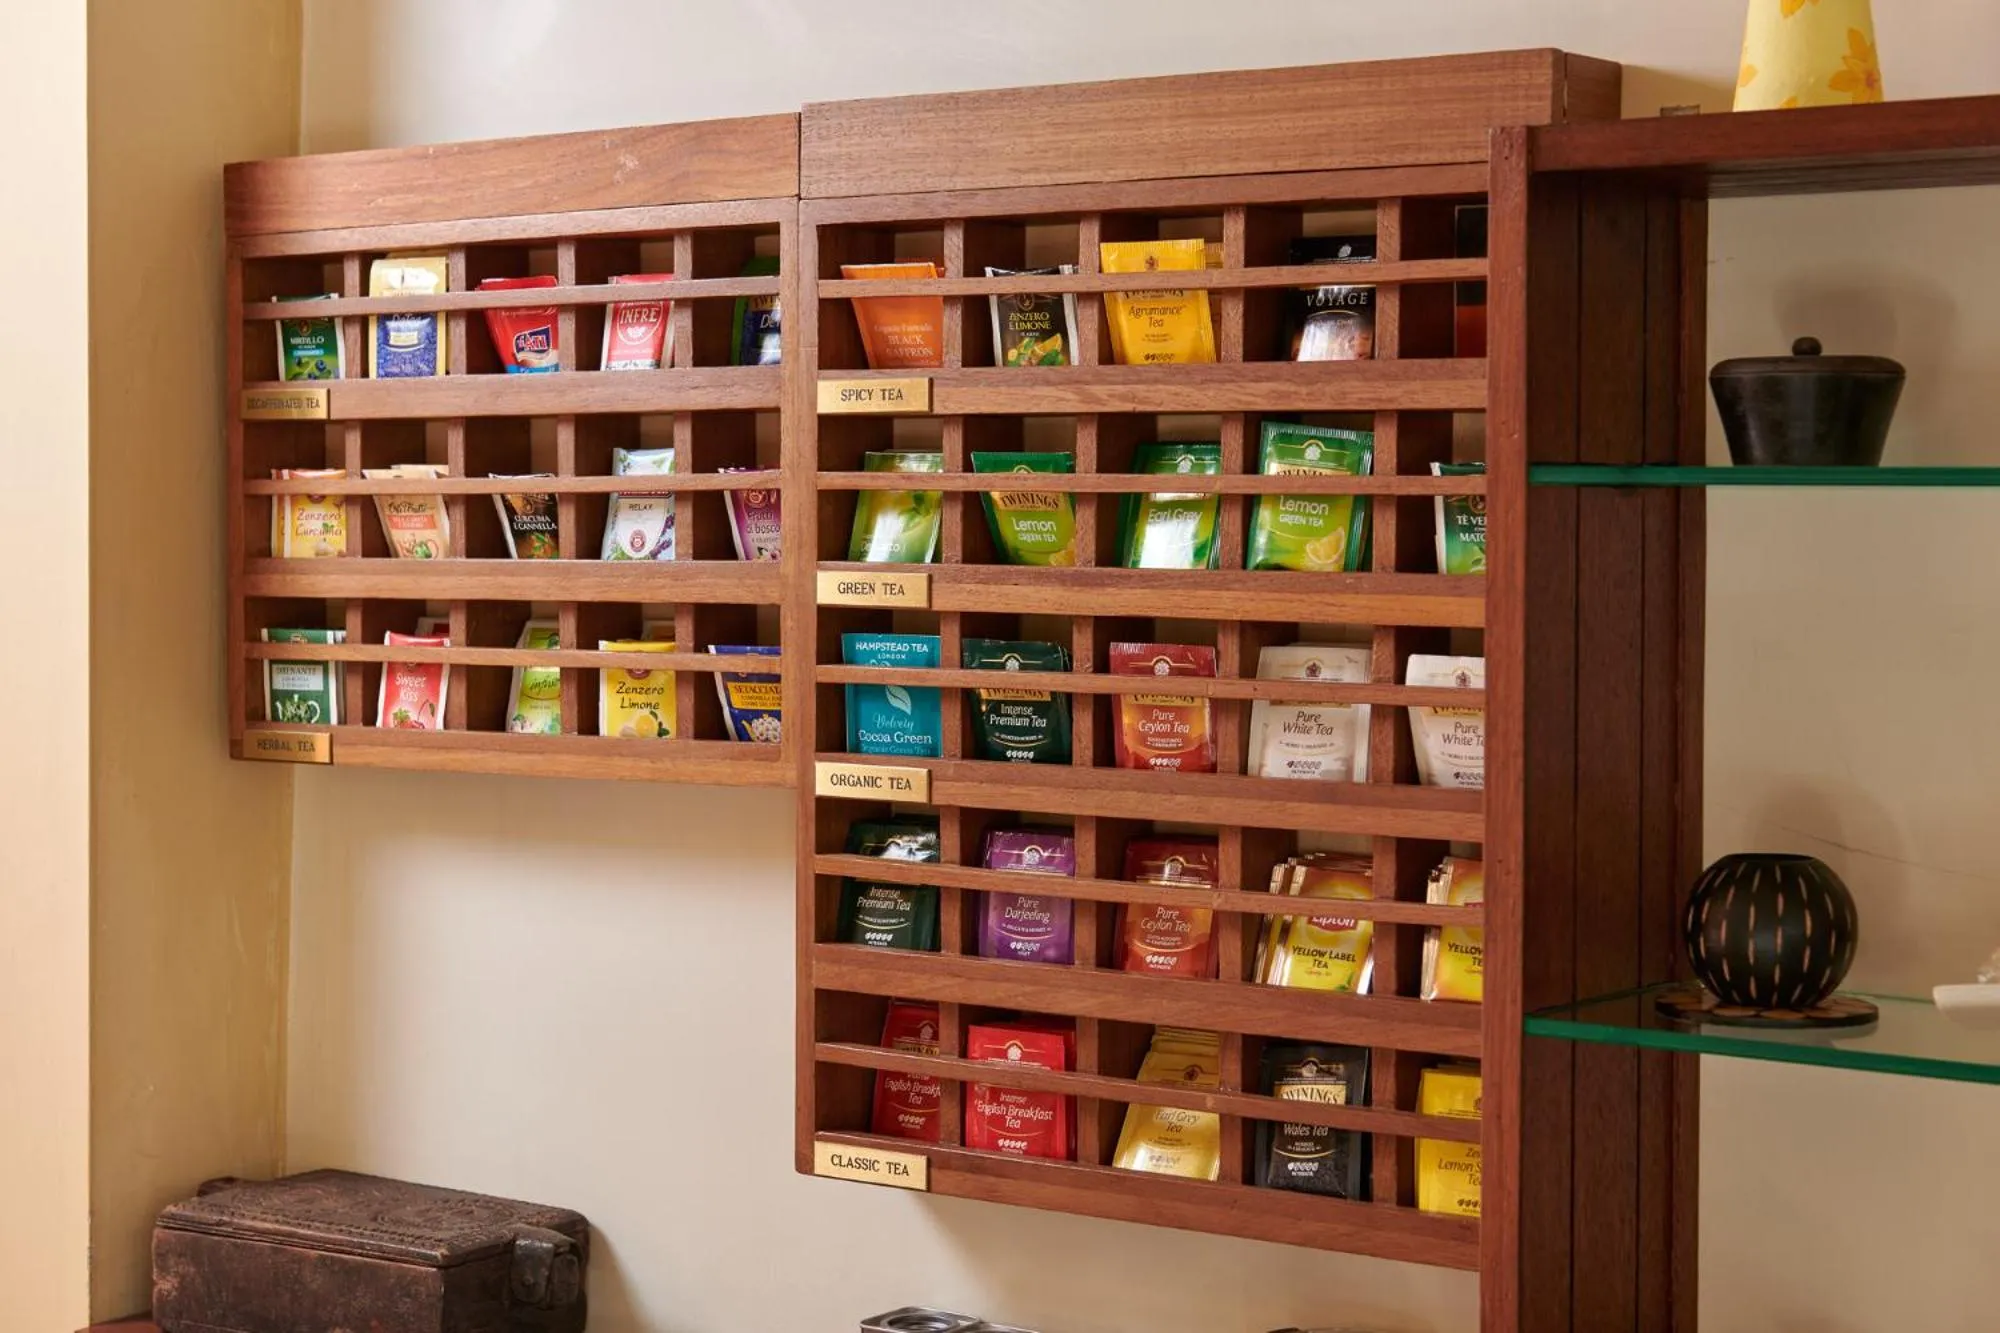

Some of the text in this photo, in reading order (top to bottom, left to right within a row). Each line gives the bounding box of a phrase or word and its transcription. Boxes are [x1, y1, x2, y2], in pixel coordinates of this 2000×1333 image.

[1306, 292, 1369, 307] VOYAGE
[1148, 316, 1165, 328] Tea
[888, 334, 925, 346] BLACK
[886, 347, 934, 359] SAFFRON
[841, 388, 904, 402] SPICY TEA
[306, 397, 320, 409] TEA
[629, 503, 654, 511] RELAX
[1001, 492, 1059, 508] TWININGS
[1280, 495, 1329, 515] Lemon
[297, 507, 342, 521] Zenzero
[296, 522, 343, 536] Curcuma
[755, 524, 781, 534] bosco
[1011, 516, 1057, 532] Lemon
[838, 582, 906, 596] GREEN TEA
[855, 641, 930, 653] HAMPSTEAD TEA
[395, 672, 428, 688] Sweet
[616, 681, 665, 695] Zenzero
[620, 697, 660, 710] Limone
[1001, 704, 1034, 716] Intense
[990, 714, 1047, 728] Premium Tea
[1152, 708, 1176, 721] Pure
[1295, 710, 1322, 723] Pure
[1138, 719, 1190, 735] Ceylon Tea
[1283, 722, 1334, 736] White Tea
[1454, 721, 1479, 734] Pure
[858, 730, 933, 745] Cocoa Green
[1442, 733, 1473, 746] White
[257, 738, 316, 752] HERBAL TEA
[830, 773, 913, 791] ORGANIC TEA
[870, 886, 901, 899] Intense
[857, 896, 912, 911] Premium Tea
[1017, 896, 1040, 909] Pure
[1004, 907, 1051, 925] Darjeeling
[1155, 906, 1180, 919] Pure
[1141, 917, 1191, 934] Ceylon Tea
[1292, 945, 1357, 963] YELLOW LABEL
[1312, 959, 1329, 970] TEA
[884, 1078, 911, 1095] English
[908, 1090, 923, 1105] Tea
[999, 1092, 1028, 1105] Intense
[979, 1101, 1053, 1121] English Breakfast
[1155, 1109, 1200, 1127] Earl Grey
[1005, 1116, 1021, 1129] Tea
[1165, 1121, 1183, 1134] Tea
[1284, 1123, 1329, 1137] Wales Tea
[830, 1154, 910, 1177] CLASSIC TEA
[1438, 1158, 1473, 1174] Lemon
